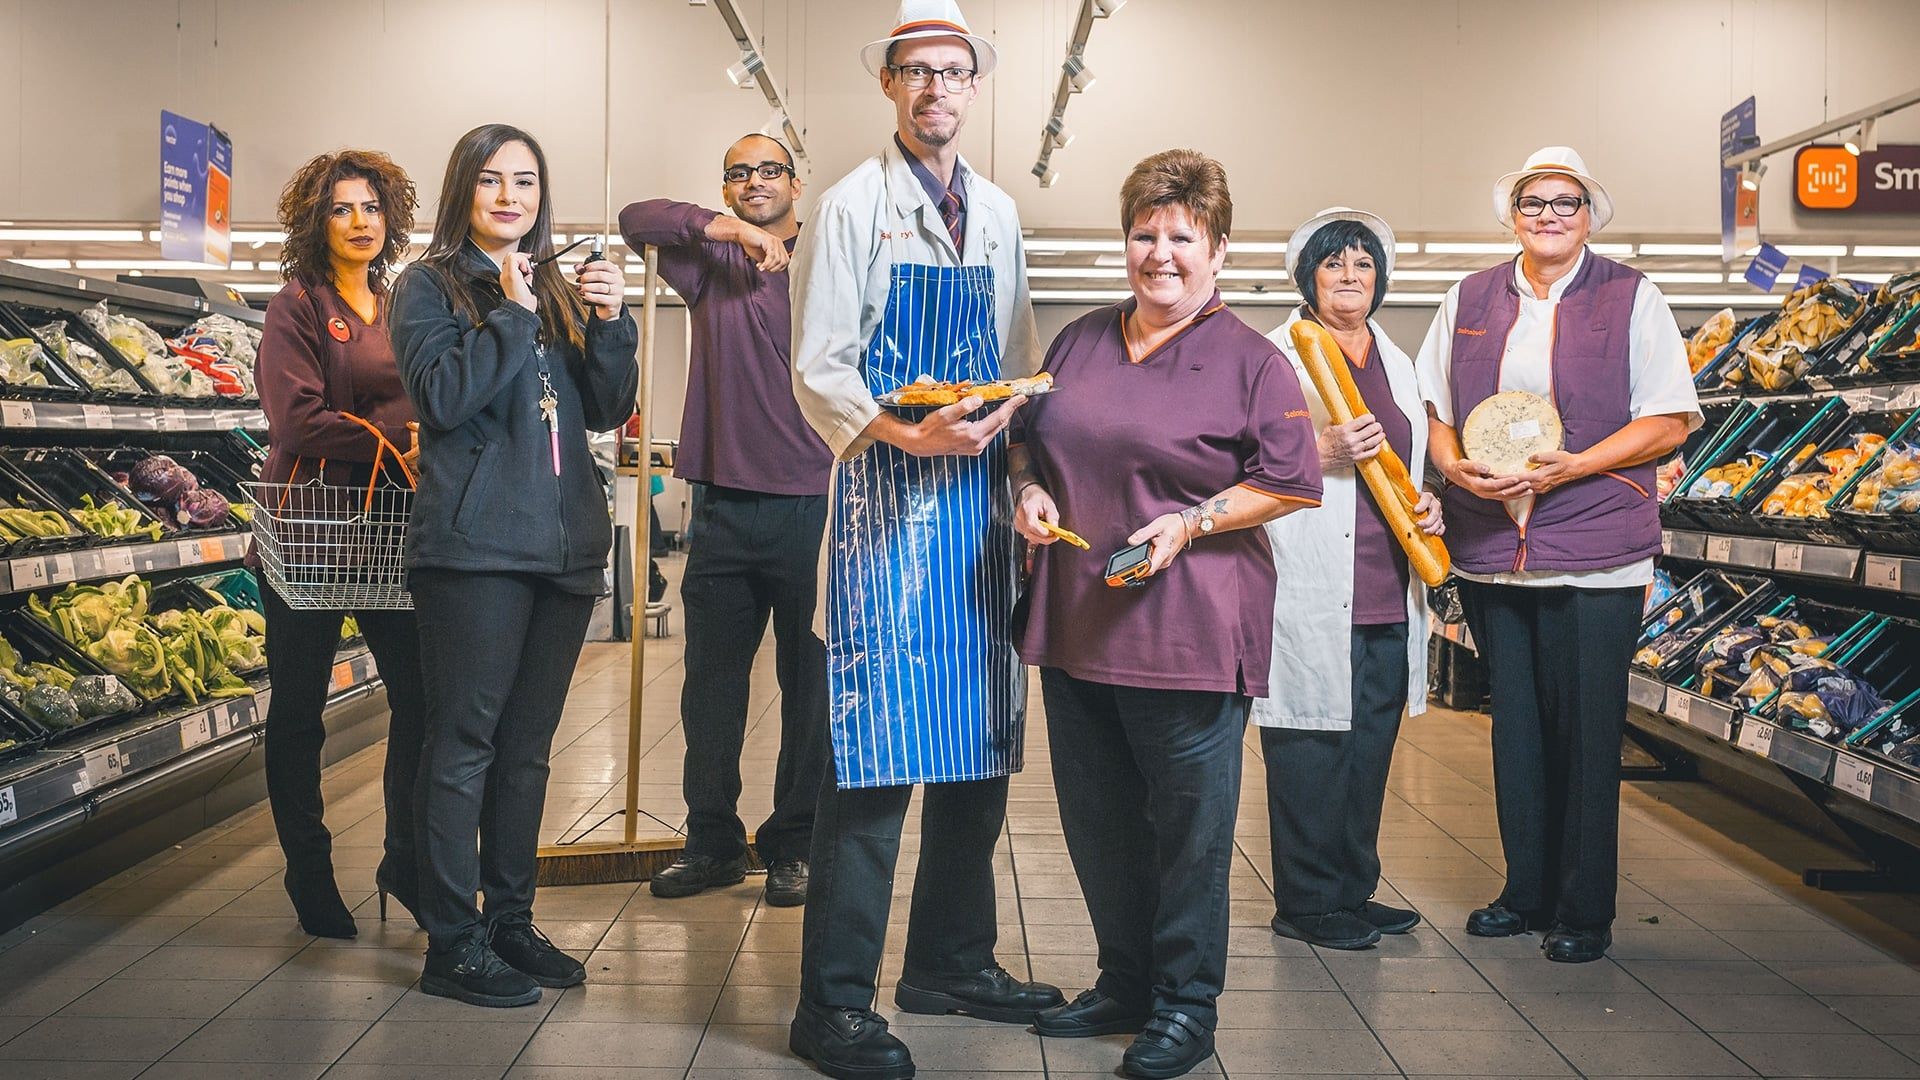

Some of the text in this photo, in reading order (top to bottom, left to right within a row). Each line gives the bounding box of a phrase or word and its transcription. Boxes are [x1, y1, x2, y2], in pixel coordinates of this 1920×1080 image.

[164, 160, 188, 179] Earn more
[164, 176, 192, 194] points when
[164, 191, 186, 208] you shop
[34, 563, 42, 578] £1
[1889, 567, 1897, 581] £1
[200, 717, 207, 734] £1
[1757, 726, 1772, 741] £2.60
[108, 753, 119, 770] 65p
[1856, 770, 1872, 786] £1.60
